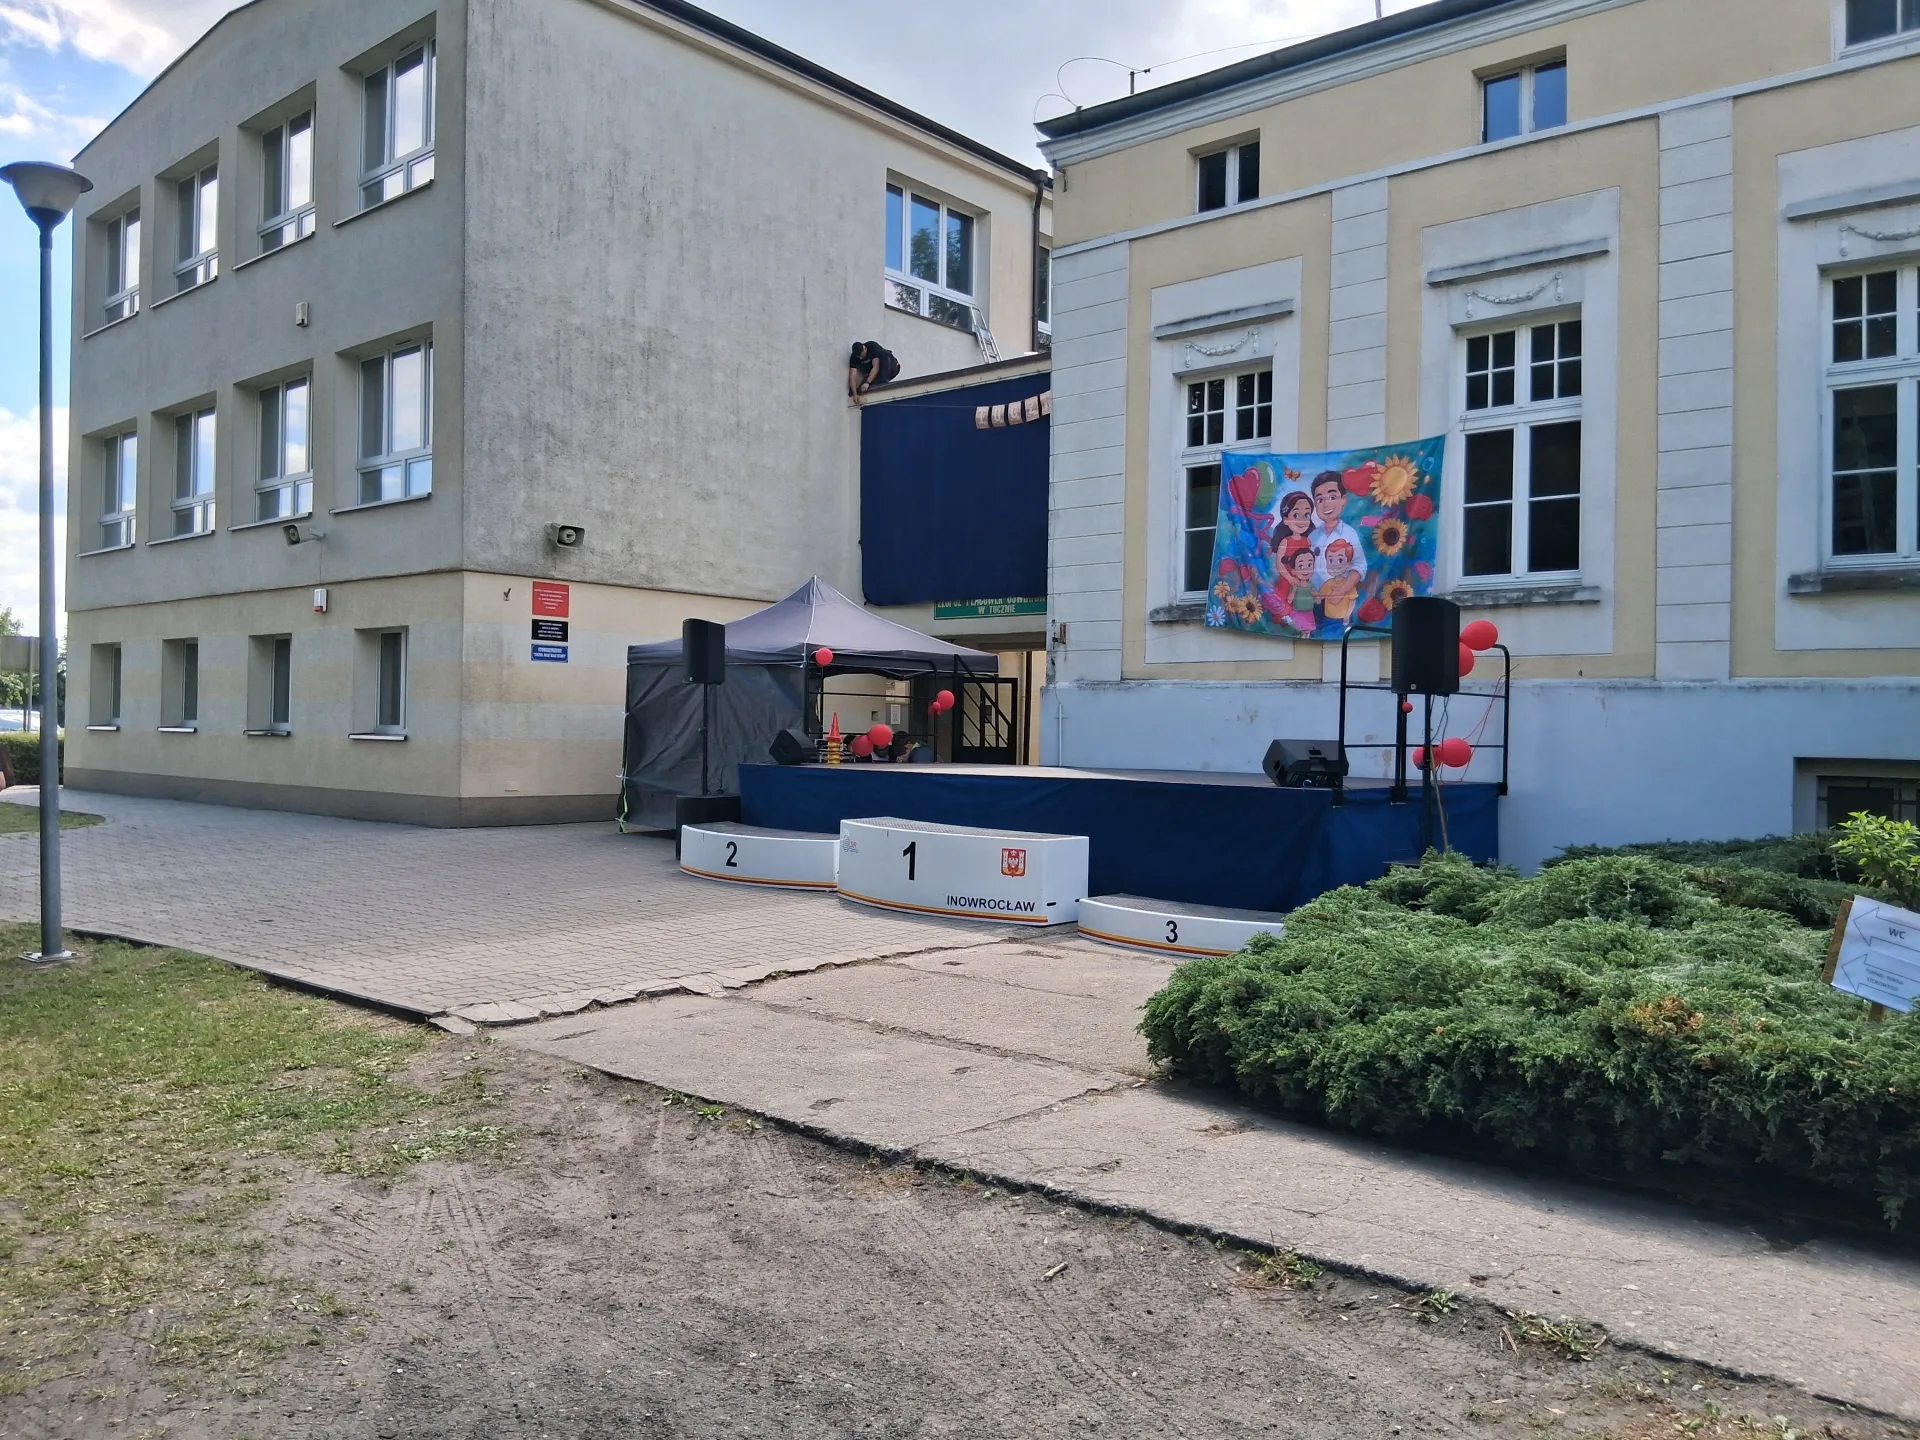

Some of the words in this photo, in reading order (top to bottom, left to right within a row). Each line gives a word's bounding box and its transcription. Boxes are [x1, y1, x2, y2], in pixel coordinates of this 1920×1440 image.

[978, 606, 985, 615] W
[989, 605, 1016, 614] TUCZNIE
[725, 840, 738, 868] 2
[902, 841, 917, 881] 1
[947, 895, 1036, 912] INOWROCŁAW
[1165, 920, 1178, 943] 3
[1889, 928, 1906, 939] WC
